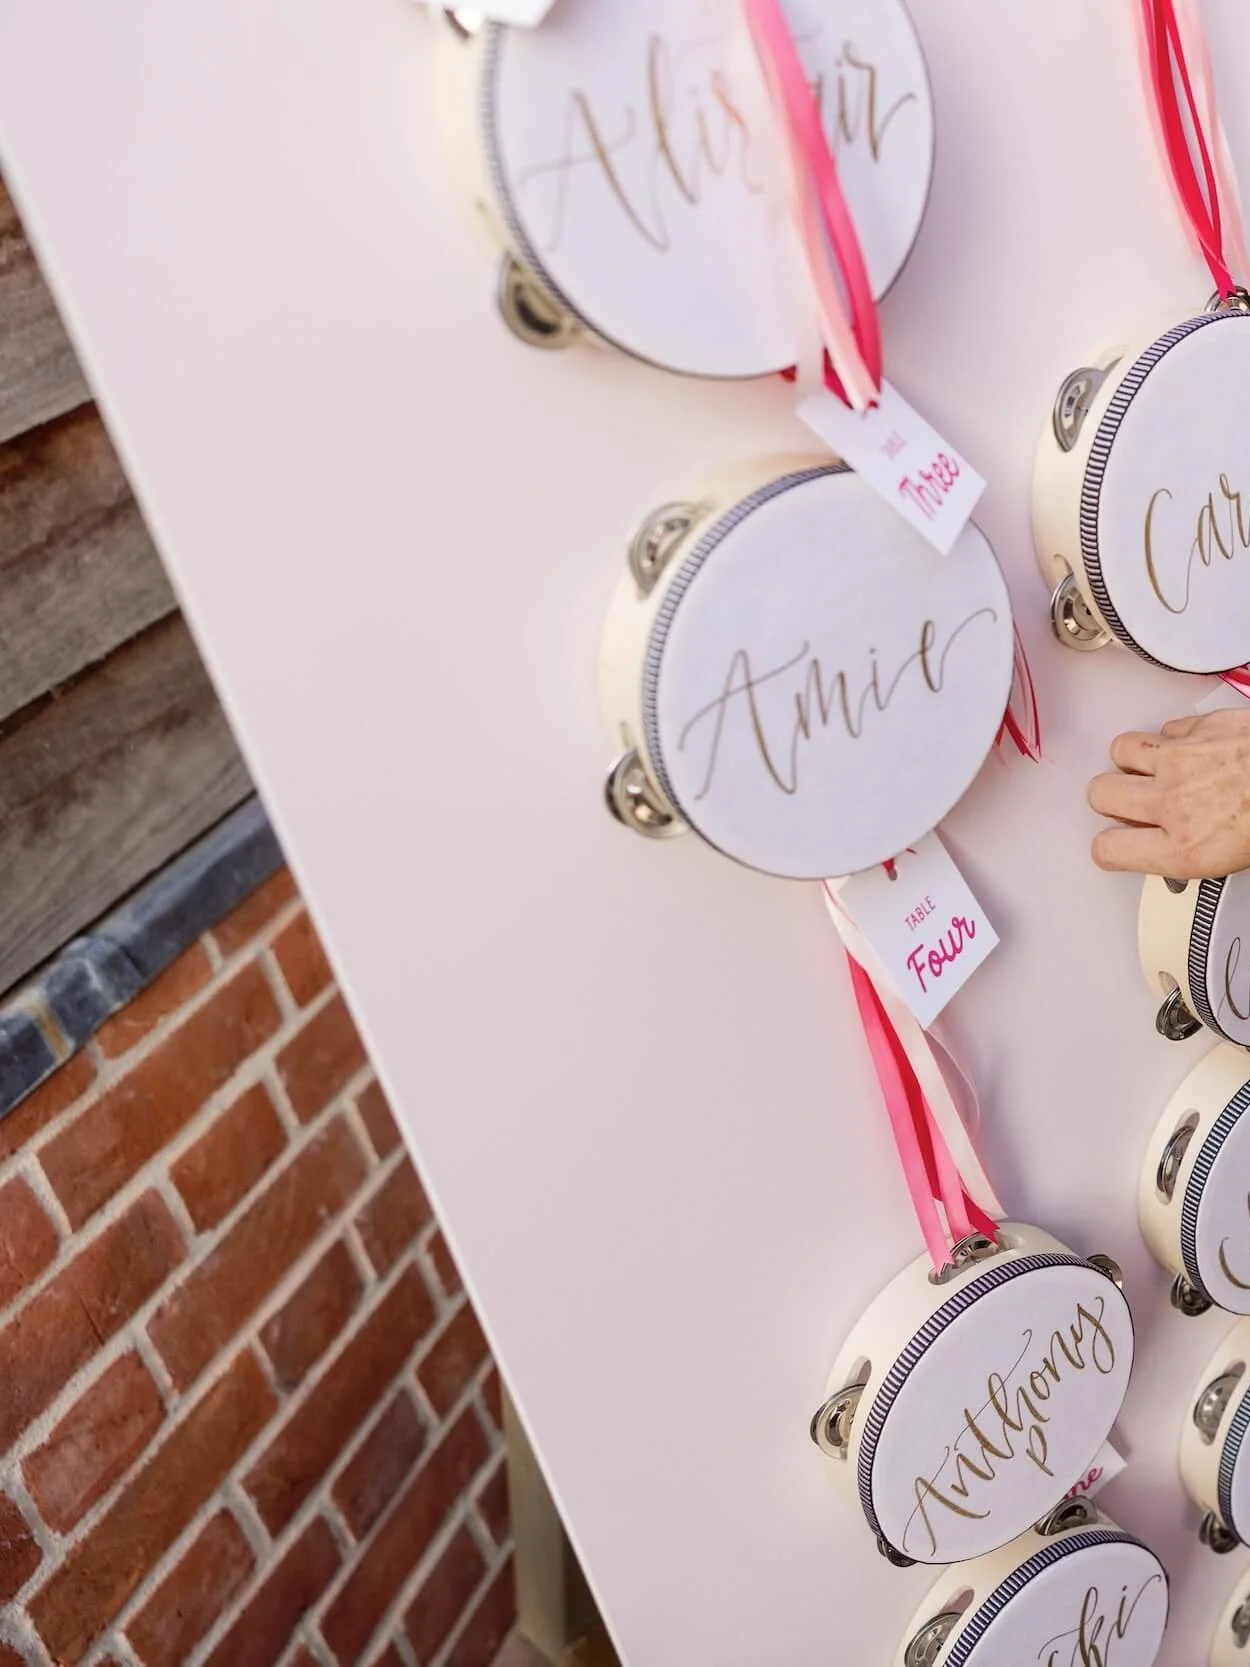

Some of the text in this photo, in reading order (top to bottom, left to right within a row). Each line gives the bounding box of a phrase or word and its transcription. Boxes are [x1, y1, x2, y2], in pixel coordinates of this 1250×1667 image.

[898, 452, 960, 521] Three
[678, 607, 998, 803] Amie
[904, 895, 936, 930] TABLE
[906, 915, 977, 993] Four
[903, 1296, 1116, 1557] Anthony
[1025, 1424, 1054, 1478] P
[1064, 1466, 1104, 1501] ne
